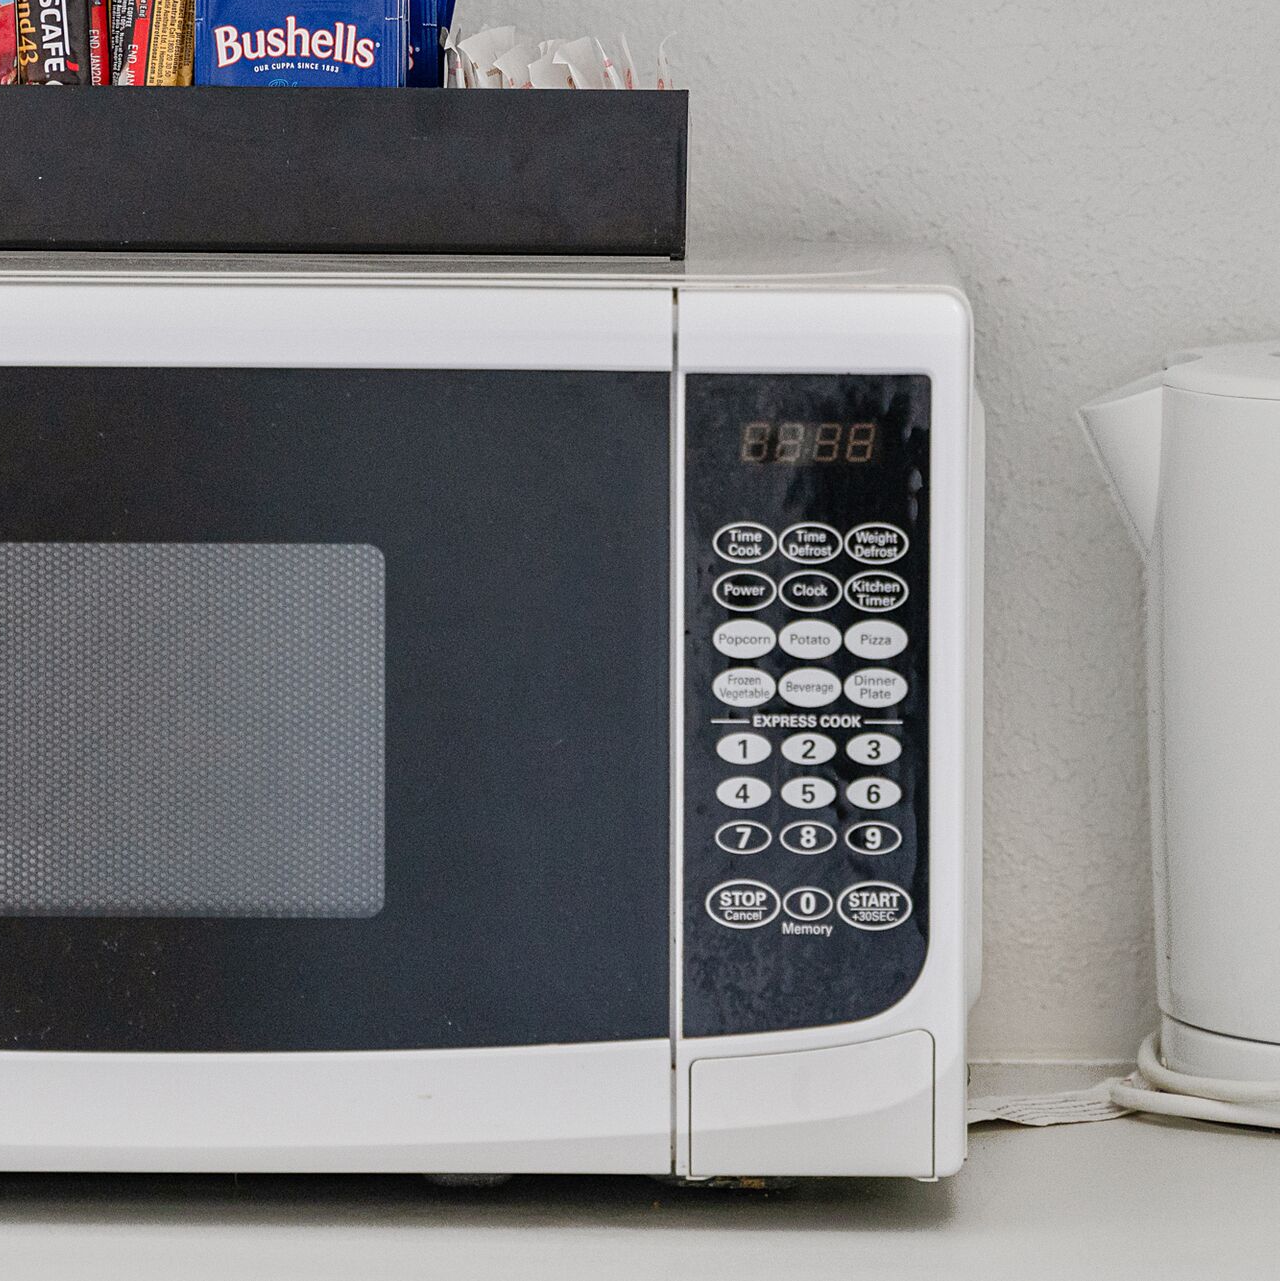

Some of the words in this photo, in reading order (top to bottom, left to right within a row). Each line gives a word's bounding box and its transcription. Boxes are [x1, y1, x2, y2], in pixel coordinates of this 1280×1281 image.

[126, 6, 134, 28] COFFEE
[138, 5, 147, 18] End
[89, 29, 99, 48] END
[214, 15, 375, 68] Bushells
[19, 36, 38, 66] 43
[127, 44, 138, 63] END
[272, 62, 295, 70] CUPPA
[298, 62, 318, 70] SINCE
[322, 64, 340, 73] 1883
[728, 530, 762, 542] Time
[796, 530, 826, 542] Time
[856, 531, 898, 546] Weight
[728, 544, 762, 556] Cook
[789, 544, 832, 556] Defrost
[854, 545, 898, 558] Defrost
[724, 584, 765, 596] Power
[792, 584, 828, 596] Clock
[852, 580, 900, 594] Kitchen
[857, 594, 896, 606] Timer
[719, 634, 770, 648] Popcorn
[790, 634, 830, 646] Potato
[860, 634, 892, 646] Pizza
[728, 675, 761, 686] Frozen
[854, 676, 896, 686] Dinner
[720, 688, 770, 702] Vegetable
[786, 682, 834, 695] Beverage
[860, 689, 892, 700] Plate
[753, 716, 817, 728] EXPRESS
[820, 716, 861, 728] COOK
[738, 739, 748, 758] 1
[802, 739, 816, 758] 2
[867, 740, 881, 760] 3
[735, 784, 750, 803] 4
[802, 784, 816, 804] 5
[866, 784, 881, 804] 6
[736, 827, 752, 849] 7
[800, 826, 816, 849] 8
[865, 828, 882, 850] 9
[720, 891, 766, 906] STOP
[800, 892, 816, 914] 0
[848, 892, 900, 908] START
[724, 910, 762, 920] Cancel
[852, 912, 898, 922] +30SEC.
[782, 923, 832, 937] Memory
